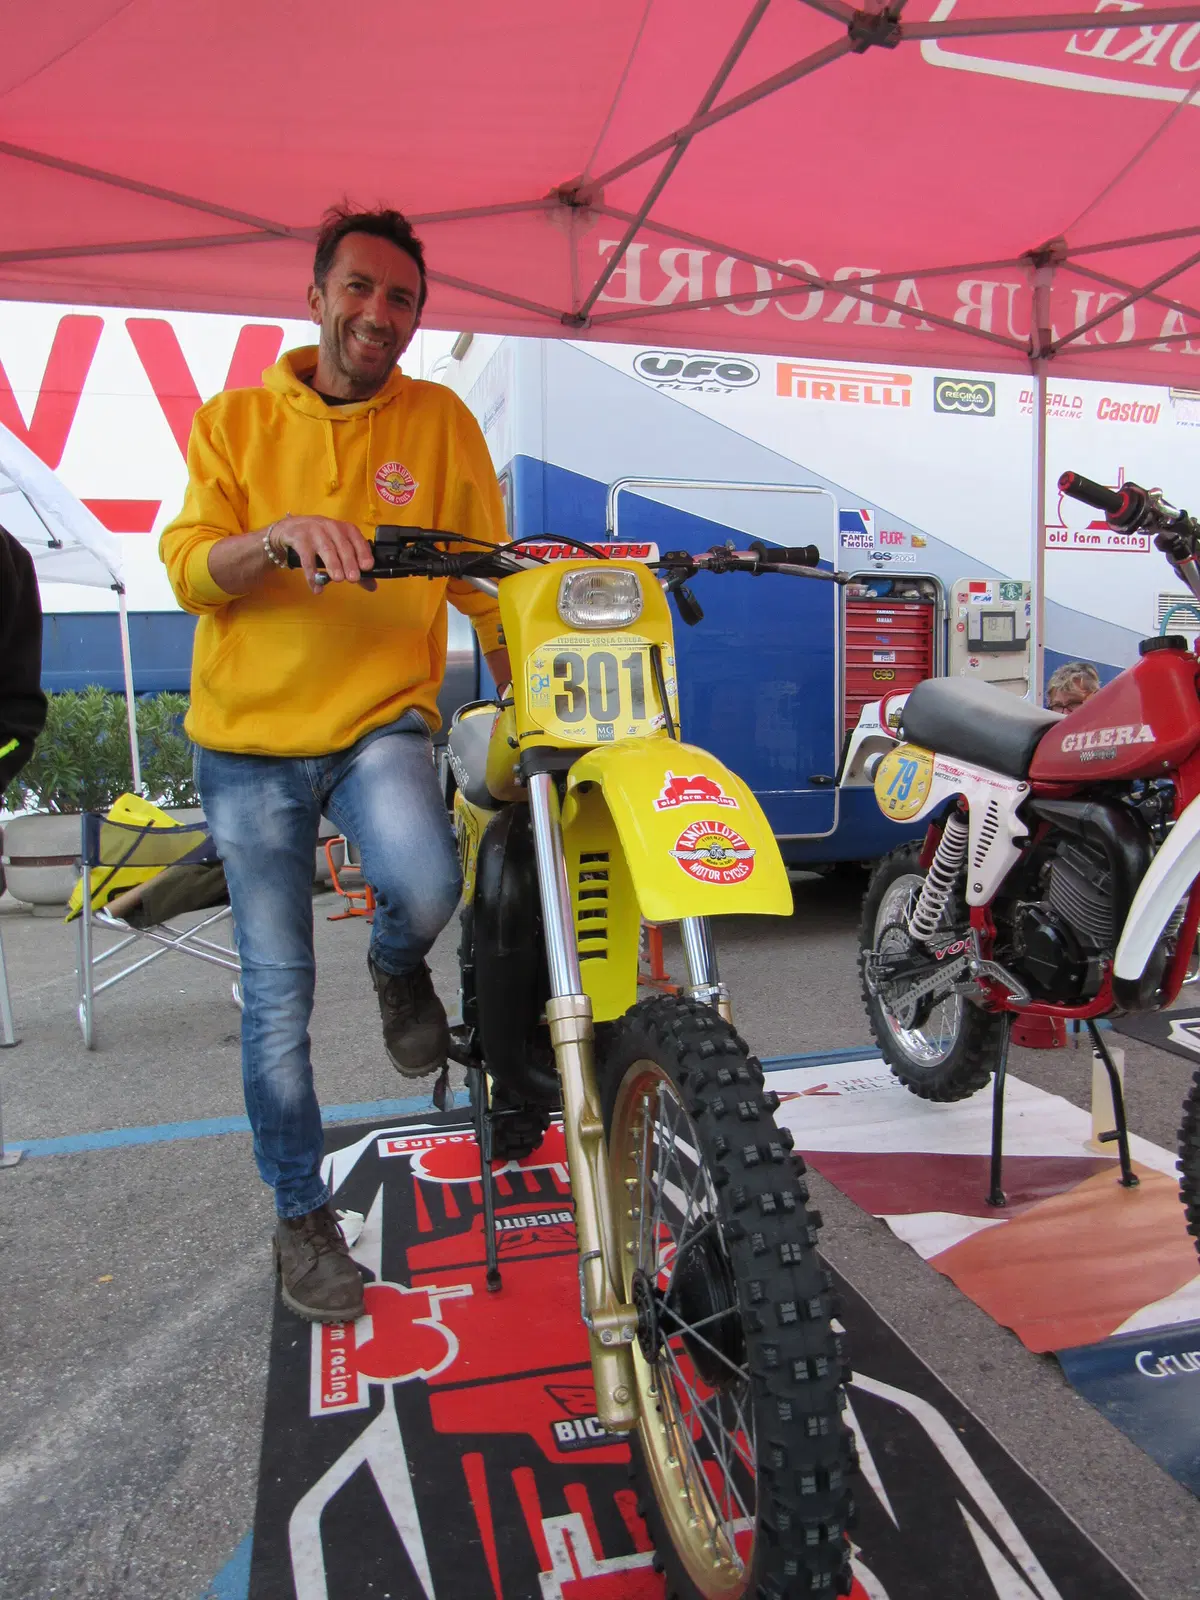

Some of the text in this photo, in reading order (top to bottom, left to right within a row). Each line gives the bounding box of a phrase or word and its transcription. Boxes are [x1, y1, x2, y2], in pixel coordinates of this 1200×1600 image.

[640, 357, 754, 382] UFO
[655, 383, 740, 394] PLAST
[776, 362, 913, 407] PIRELLI
[945, 391, 984, 400] REGINA
[1096, 397, 1161, 425] Castrol
[840, 534, 874, 546] FANTIC
[847, 539, 874, 548] MOTOR
[1049, 531, 1145, 548] old farm racing
[553, 651, 646, 723] 301
[597, 726, 614, 735] MG
[1061, 725, 1157, 752] GILERA
[886, 757, 919, 801] 79
[660, 798, 677, 806] old
[679, 821, 746, 849] ANCILLOTTI
[689, 862, 750, 881] MOTOR CYCLES
[323, 1347, 352, 1403] racing
